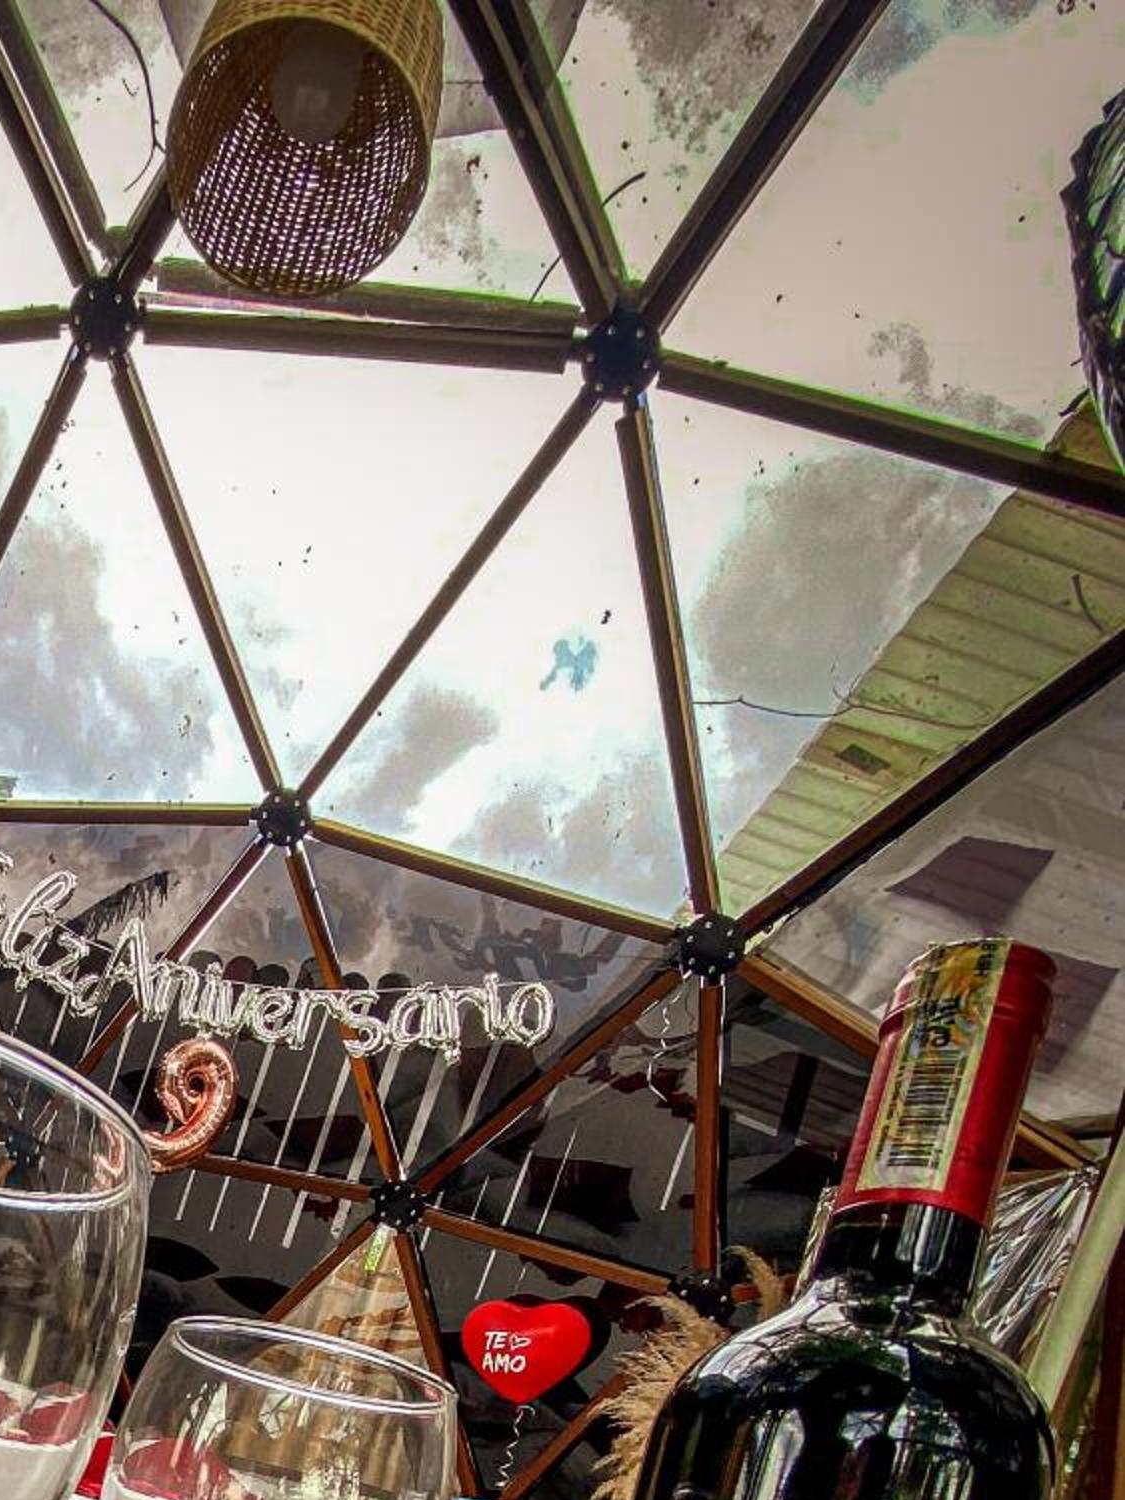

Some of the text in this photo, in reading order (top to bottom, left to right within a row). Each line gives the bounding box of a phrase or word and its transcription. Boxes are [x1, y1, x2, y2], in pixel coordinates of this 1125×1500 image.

[69, 917, 556, 1066] Aniversario
[484, 1331, 508, 1350] TE
[482, 1352, 526, 1374] AMO
